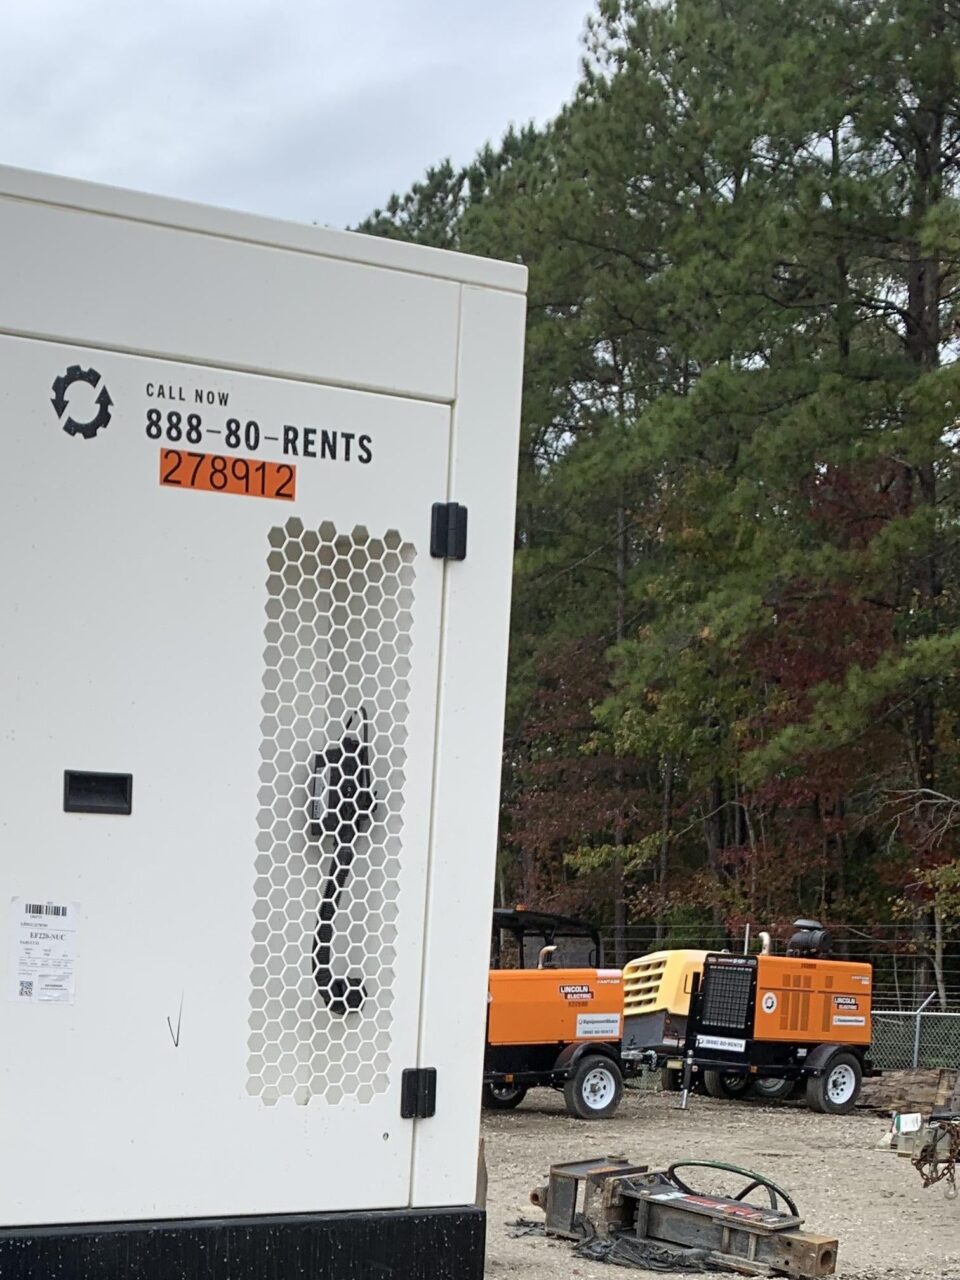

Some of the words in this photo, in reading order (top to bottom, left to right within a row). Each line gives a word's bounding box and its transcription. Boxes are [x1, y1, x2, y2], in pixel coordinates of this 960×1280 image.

[146, 383, 186, 401] CALL
[195, 389, 229, 406] NOW
[145, 408, 373, 464] 888-80-RENTS
[162, 449, 294, 498] 278912
